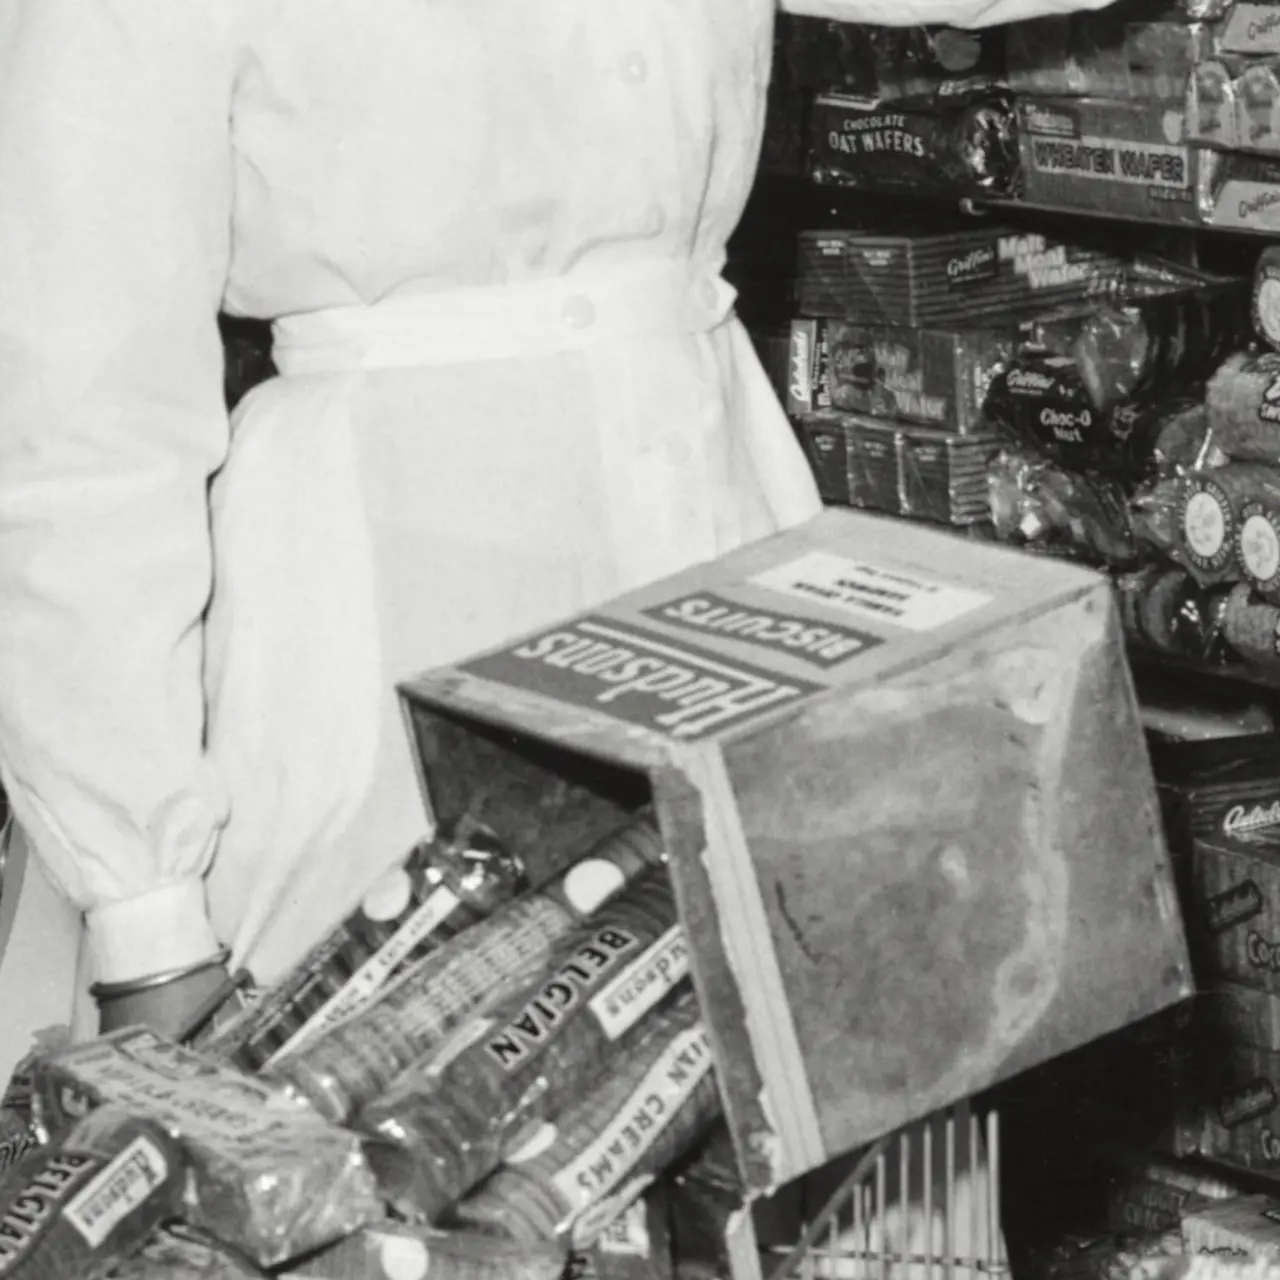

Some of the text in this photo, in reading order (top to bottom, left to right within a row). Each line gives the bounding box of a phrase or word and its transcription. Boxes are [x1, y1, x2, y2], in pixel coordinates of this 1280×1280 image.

[827, 129, 925, 157] OAT WAFERS
[1034, 140, 1185, 183] WHEATEN WAFER
[661, 596, 864, 660] BISCUITS
[513, 628, 803, 736] Hudsons
[490, 929, 632, 1066] BELGIAN
[575, 1092, 665, 1192] CREAMS
